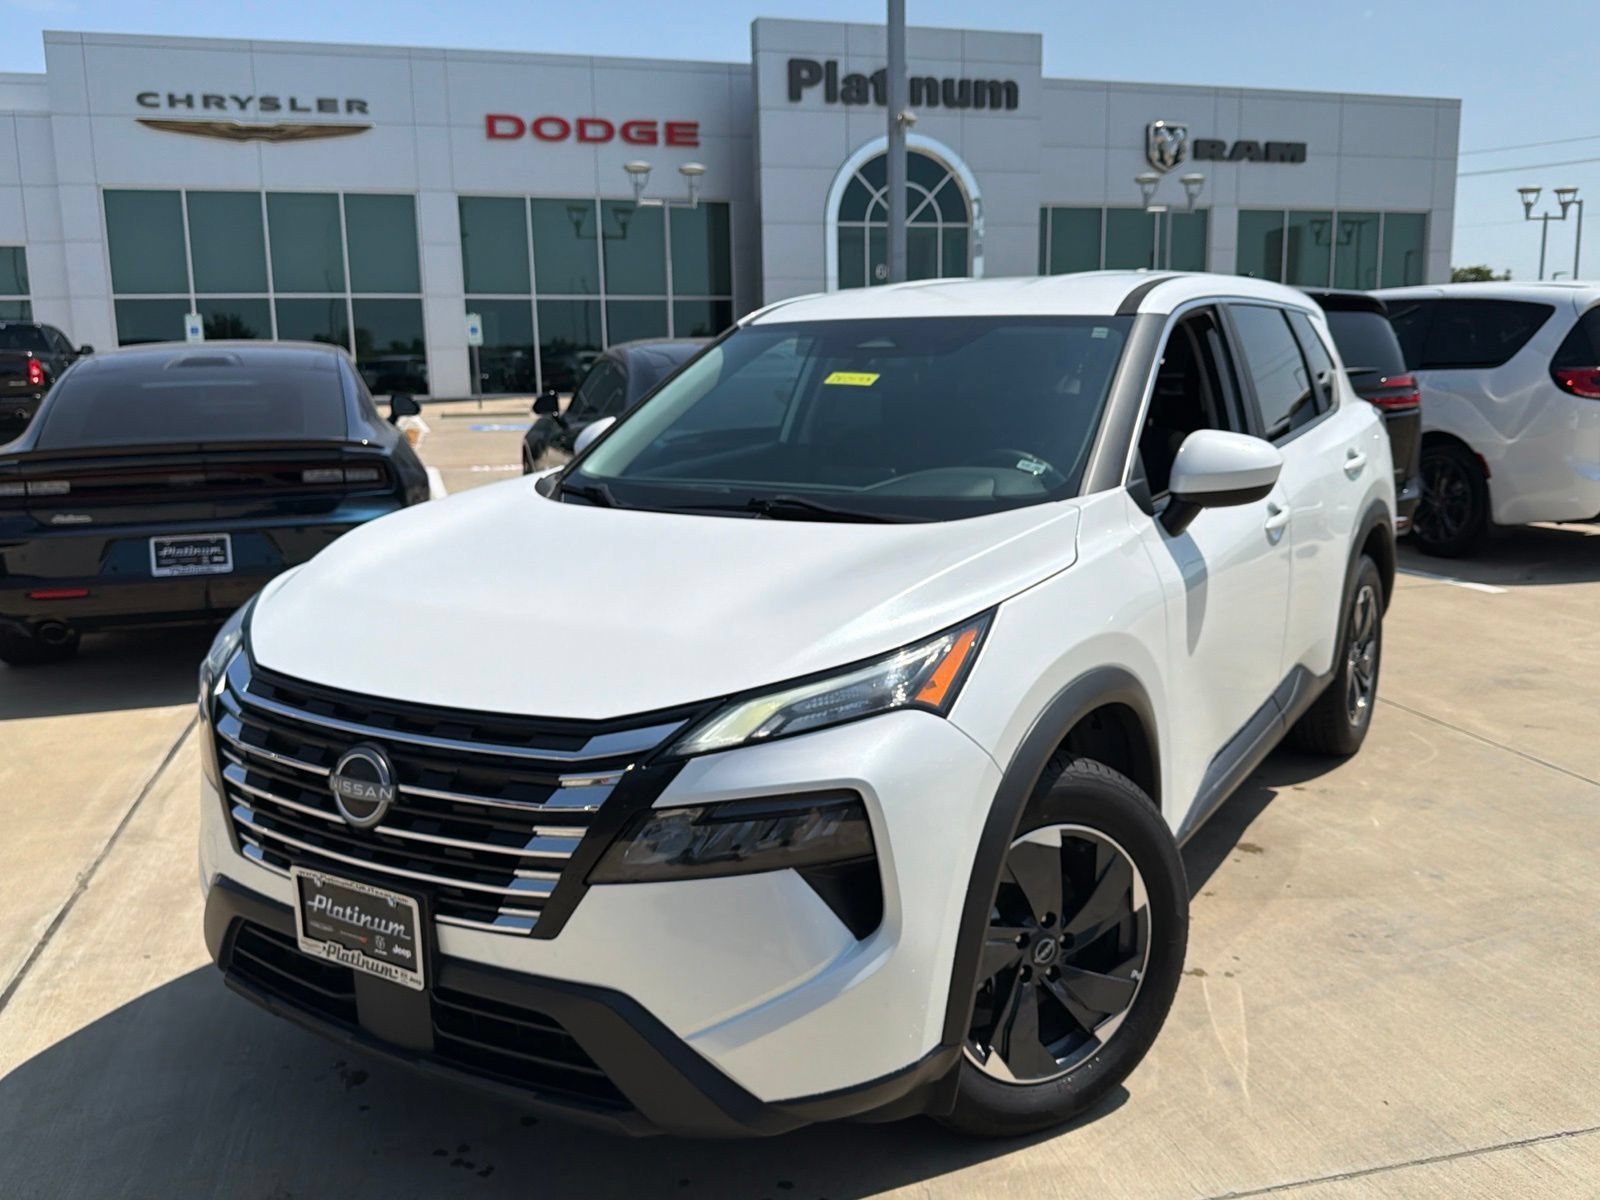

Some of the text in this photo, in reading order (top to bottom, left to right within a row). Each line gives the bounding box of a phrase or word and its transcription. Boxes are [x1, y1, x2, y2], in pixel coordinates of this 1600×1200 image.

[787, 57, 1019, 110] Platnum
[135, 91, 369, 115] CHRYSLER
[484, 113, 700, 148] DODGE
[1193, 138, 1307, 164] RAM
[330, 774, 393, 800] NISSAN
[306, 893, 411, 940] Platinum
[325, 942, 399, 979] Platinum
[392, 944, 412, 959] Jeep
